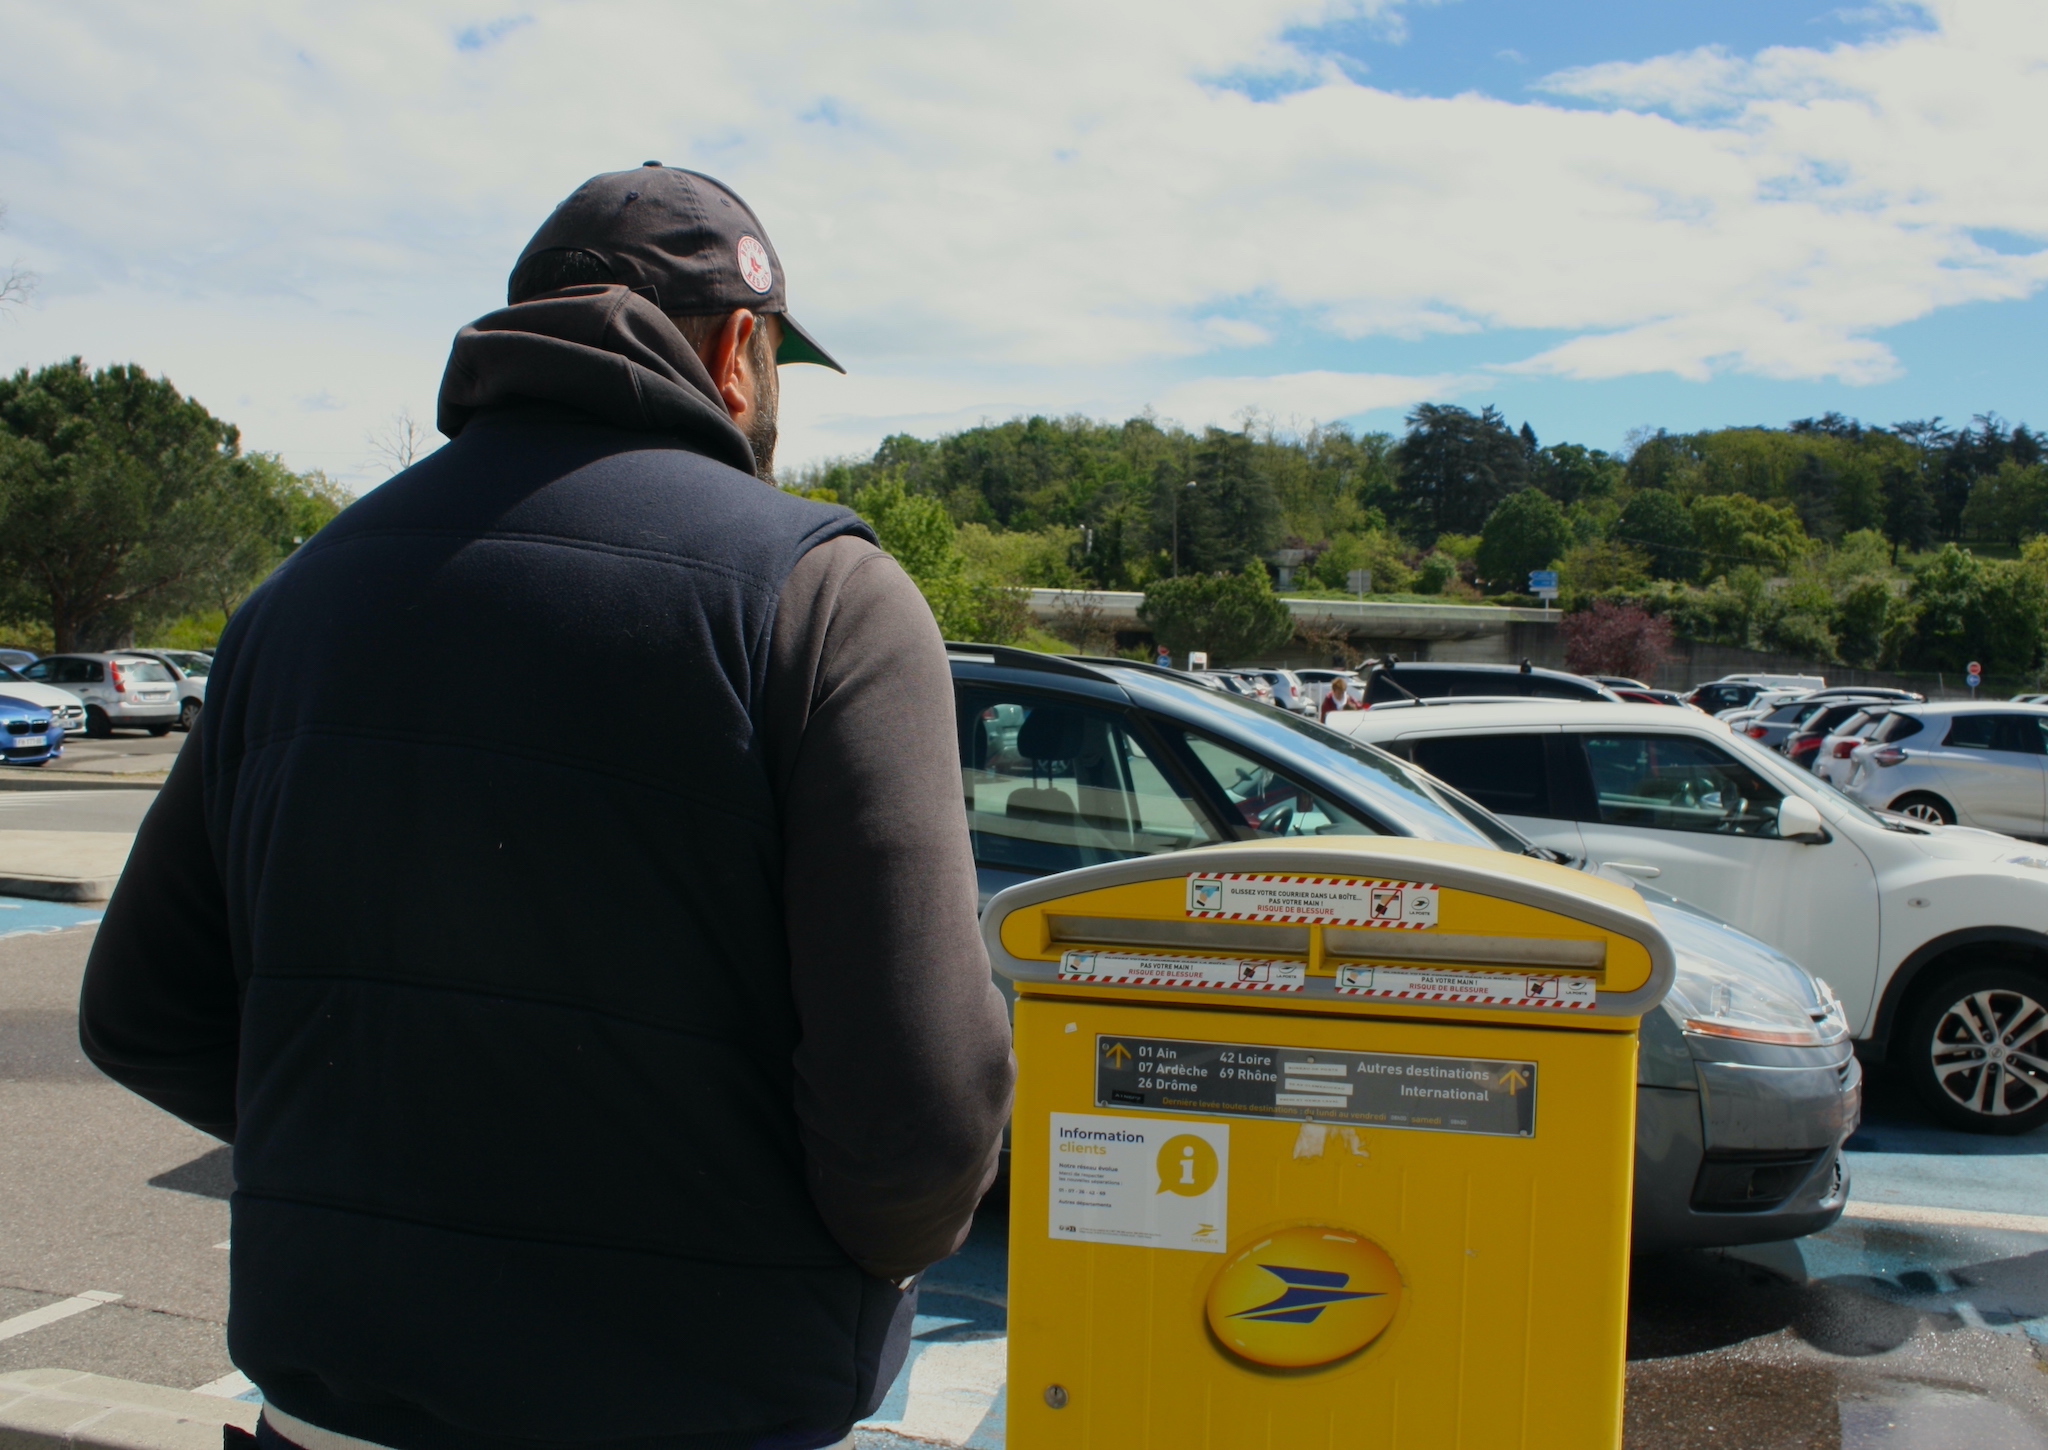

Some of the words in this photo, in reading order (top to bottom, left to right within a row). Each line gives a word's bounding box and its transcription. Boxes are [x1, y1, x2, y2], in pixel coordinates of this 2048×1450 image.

[1277, 890, 1310, 899] COURRIER
[1257, 905, 1283, 914] RISQUE
[1296, 906, 1334, 915] BLESSURE
[1409, 983, 1434, 992] RISQUE
[1449, 985, 1488, 994] BLESSURE
[1139, 1046, 1152, 1057] 01
[1156, 1047, 1177, 1059] Ain
[1220, 1052, 1234, 1064] 42
[1238, 1052, 1271, 1066] Loire
[1139, 1062, 1153, 1073] 07
[1156, 1062, 1208, 1077] Ardèche
[1220, 1068, 1234, 1079] 69
[1238, 1068, 1277, 1082] Rhône
[1357, 1062, 1402, 1075] Autres
[1406, 1065, 1489, 1080] destinations
[1138, 1077, 1152, 1088] 26
[1156, 1078, 1198, 1092] Drôme
[1401, 1085, 1489, 1101] International
[1162, 1096, 1197, 1106] Dernière
[1198, 1098, 1221, 1108] levée
[1222, 1100, 1248, 1110] toutes
[1249, 1102, 1298, 1114] destinations
[1316, 1108, 1337, 1117] lundi
[1351, 1112, 1386, 1120] vendredi
[1411, 1116, 1442, 1125] samedi
[1060, 1127, 1144, 1143] Information
[1059, 1142, 1106, 1155] clients
